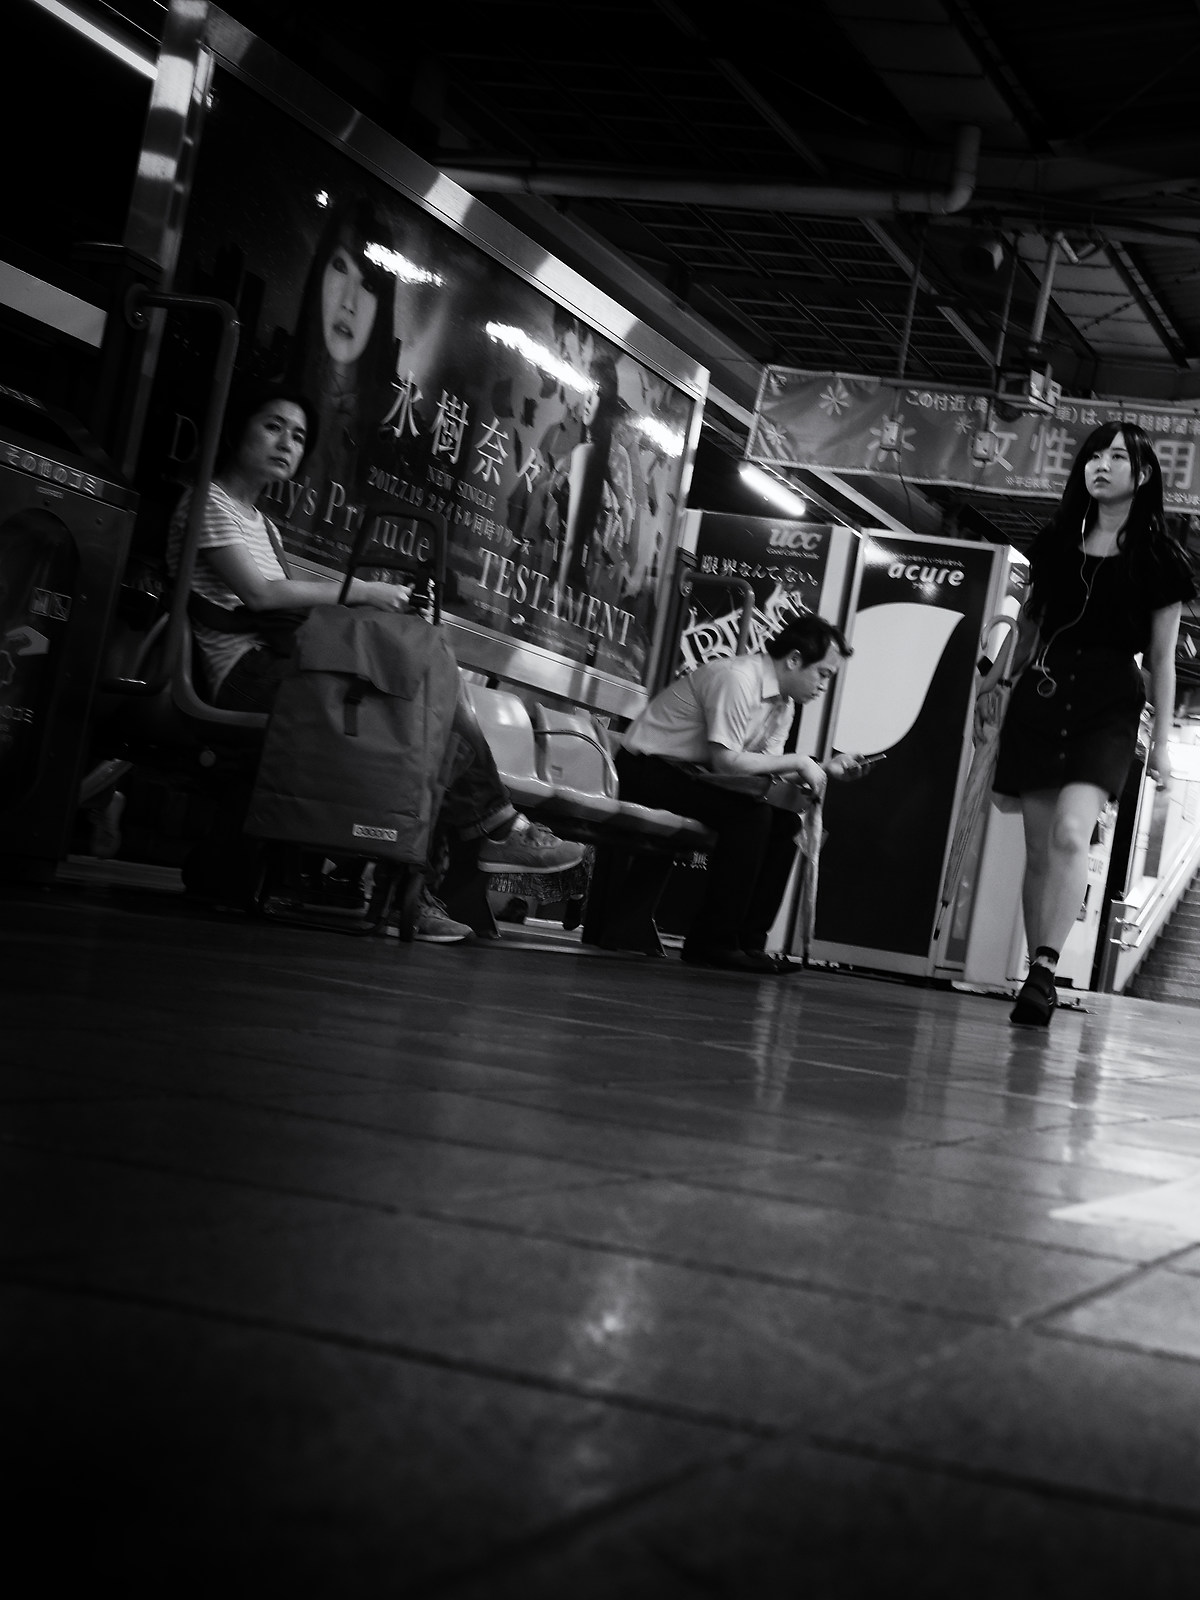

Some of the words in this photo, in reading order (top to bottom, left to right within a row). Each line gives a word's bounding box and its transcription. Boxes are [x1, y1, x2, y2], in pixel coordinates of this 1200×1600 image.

[380, 371, 542, 494] 水樹奈々
[5, 444, 98, 497] その他のゴミ
[426, 463, 456, 491] NEW
[456, 479, 497, 512] SINGLE
[322, 479, 432, 563] Prlude
[477, 546, 636, 647] TESTAMENT
[887, 563, 966, 587] acure
